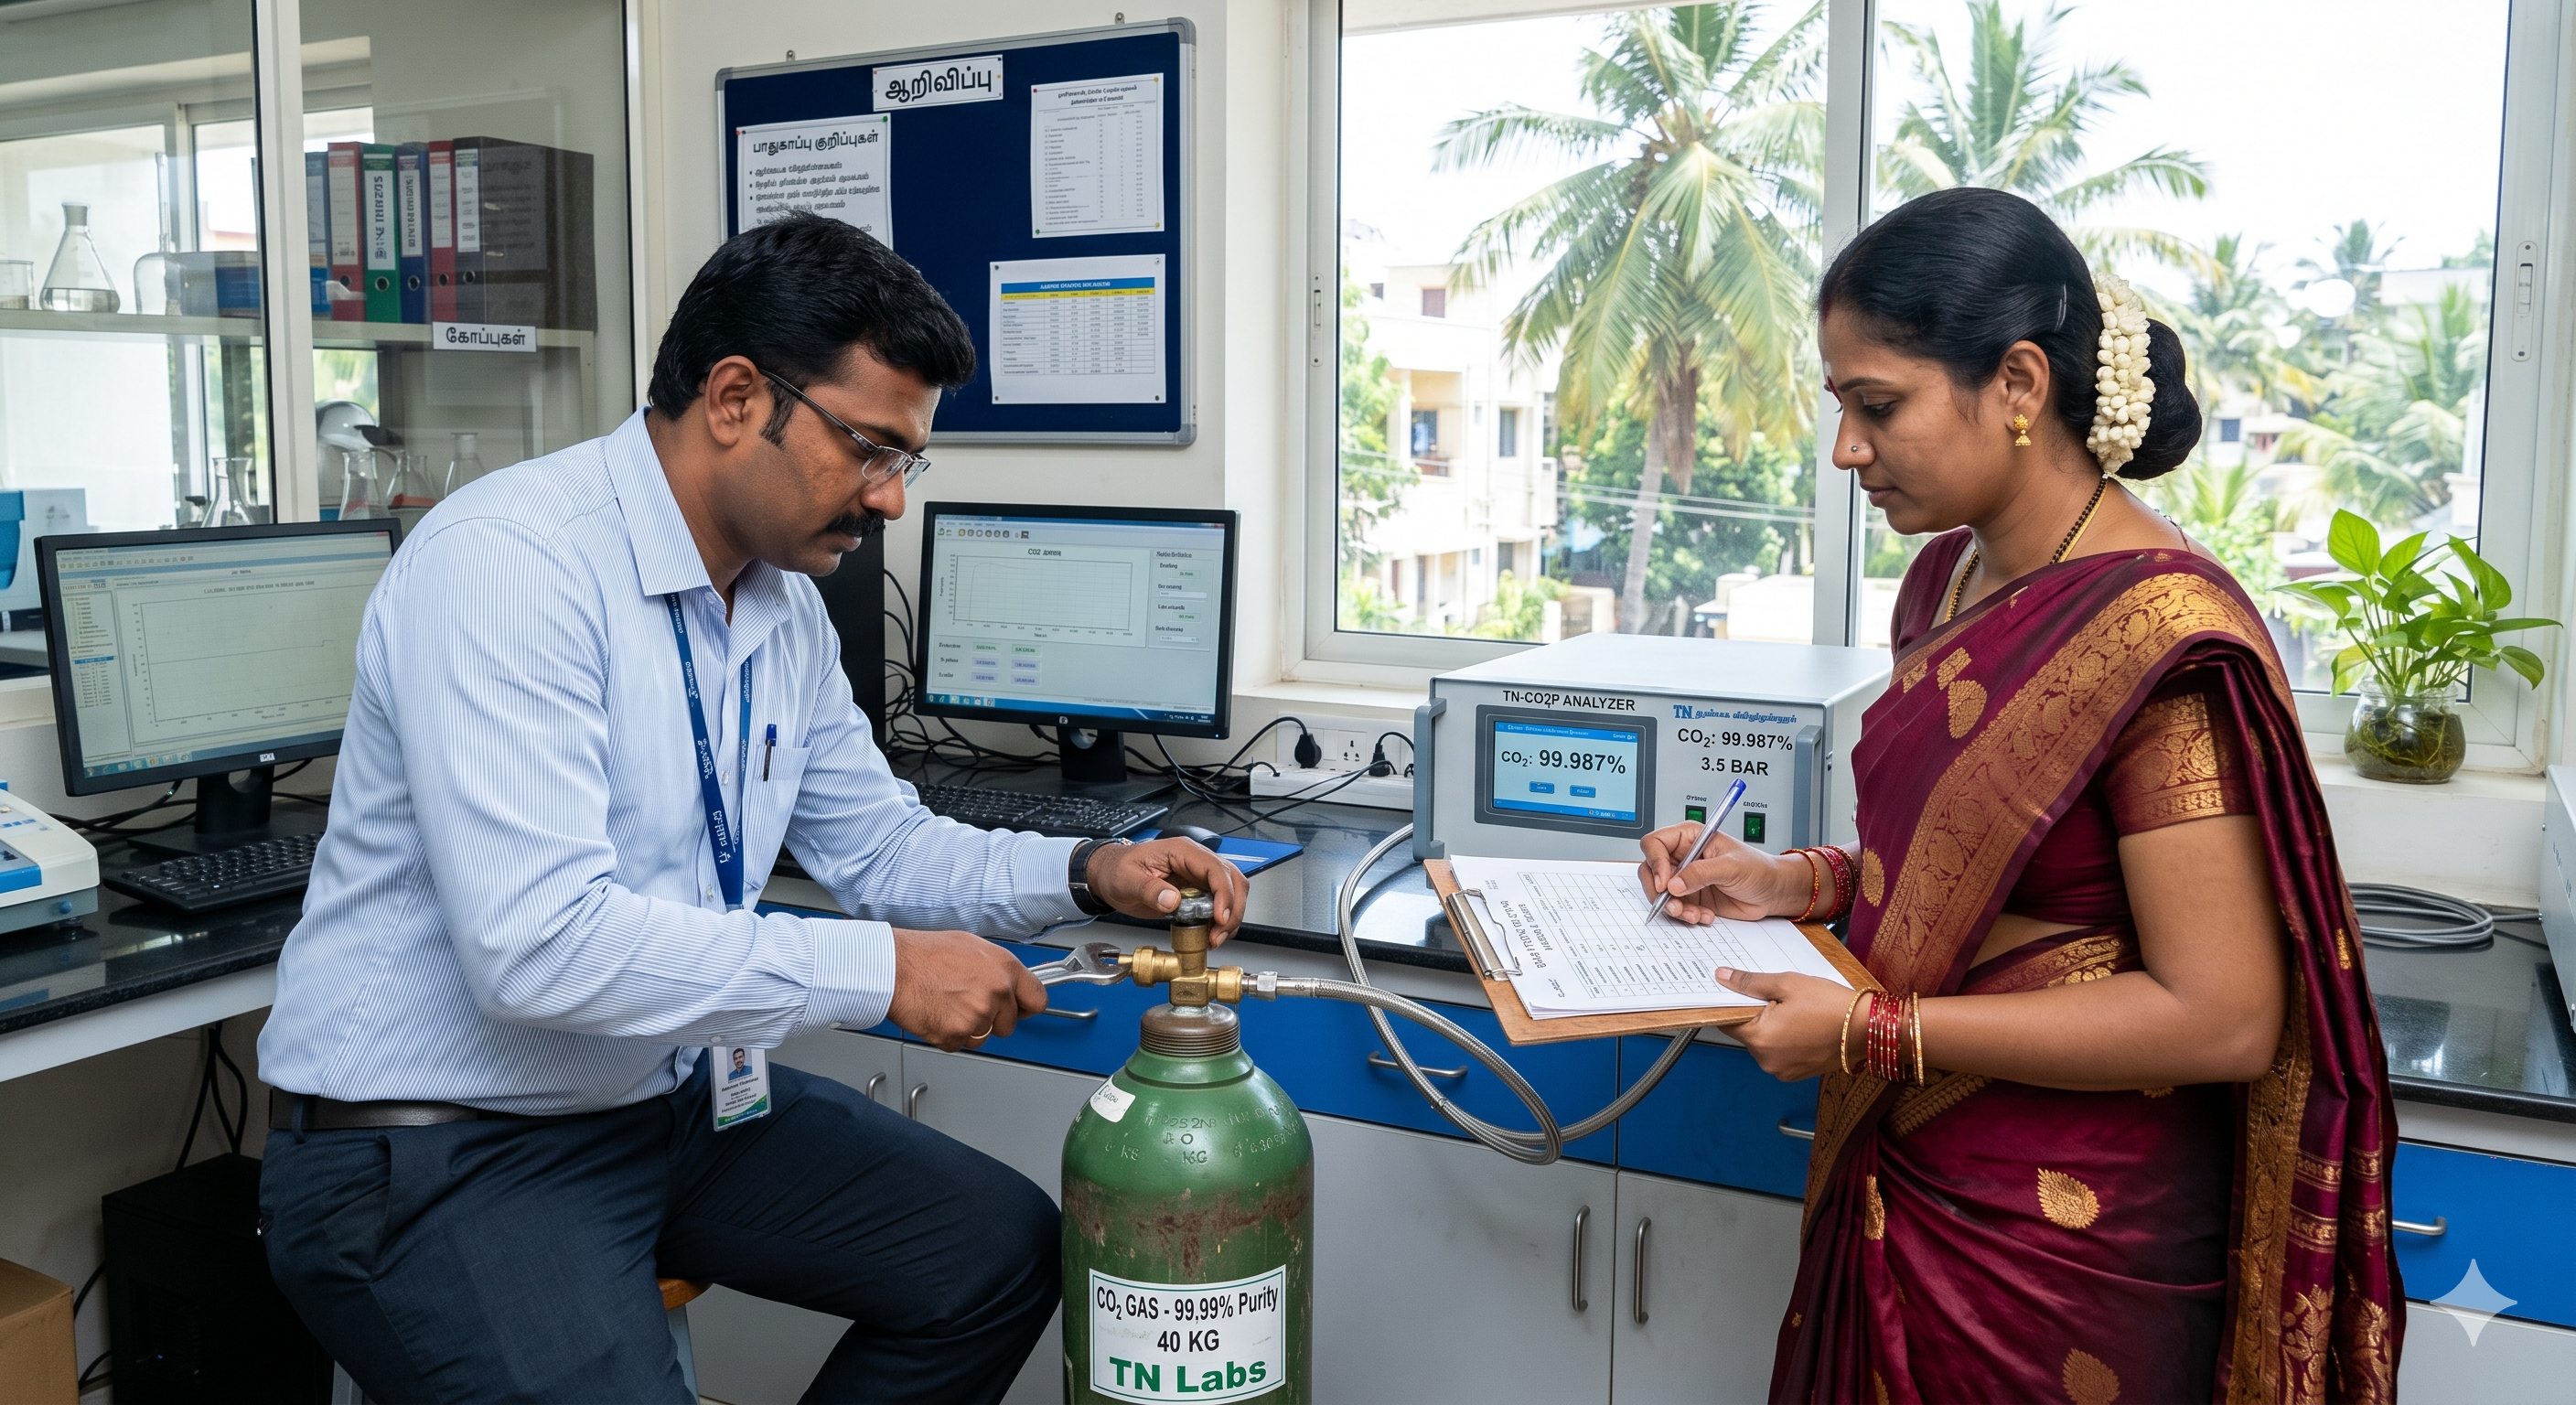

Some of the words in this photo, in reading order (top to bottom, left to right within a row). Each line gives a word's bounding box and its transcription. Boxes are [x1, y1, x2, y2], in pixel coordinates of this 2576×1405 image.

[886, 66, 992, 103] ஆறிவிப்பு
[446, 327, 526, 348] கோப்புகள்
[1562, 694, 1636, 711] ANALYZER
[1673, 704, 1693, 719] TN
[1722, 732, 1793, 750] 99.987%
[1539, 749, 1626, 774] 99.987%
[1701, 757, 1725, 772] 3.5
[1731, 759, 1768, 776] BAR
[1126, 1293, 1158, 1320] GAS
[1239, 1285, 1278, 1315] Purity
[1157, 1330, 1181, 1353] 40
[1189, 1329, 1220, 1353] KG
[1109, 1357, 1160, 1392] TN
[1177, 1360, 1267, 1393] Labs
